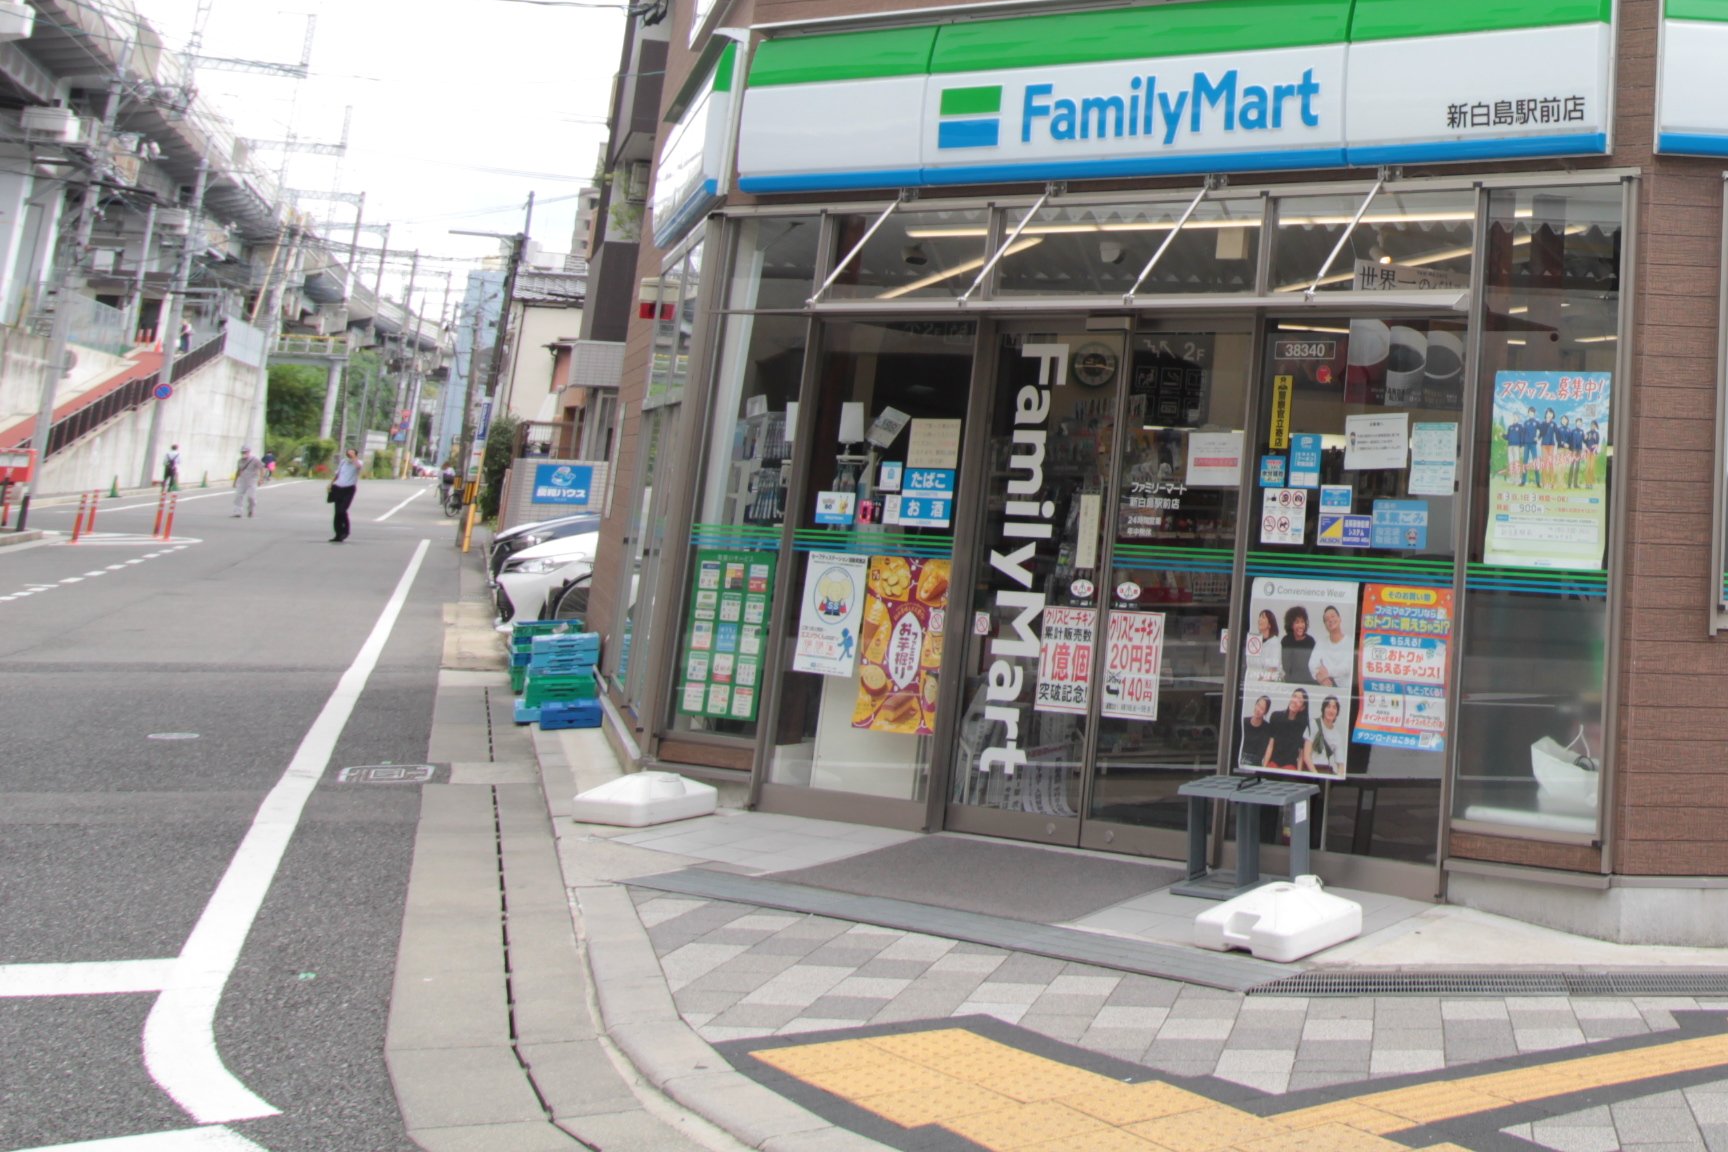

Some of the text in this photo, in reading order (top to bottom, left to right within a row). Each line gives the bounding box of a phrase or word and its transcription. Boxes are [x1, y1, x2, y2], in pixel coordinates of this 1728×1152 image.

[1020, 65, 1322, 146] FamilyMart
[1446, 94, 1586, 130] 新白島駅前店
[1284, 343, 1326, 358] 38340
[911, 471, 946, 489] たばこ
[1131, 481, 1187, 495] ファミリーマート
[907, 499, 945, 518] お酒
[1129, 496, 1180, 510] 新白島駅前店
[980, 343, 1070, 775] FamilyMart
[1277, 585, 1346, 598] Convenience Wear
[1045, 609, 1096, 627] クリスピーチキン
[1044, 626, 1092, 642] 累計販売数
[1109, 615, 1161, 644] クリスピーチキン
[1040, 643, 1091, 684] 1億個
[1109, 643, 1159, 675] 20円引
[1038, 683, 1088, 704] 突破記念!
